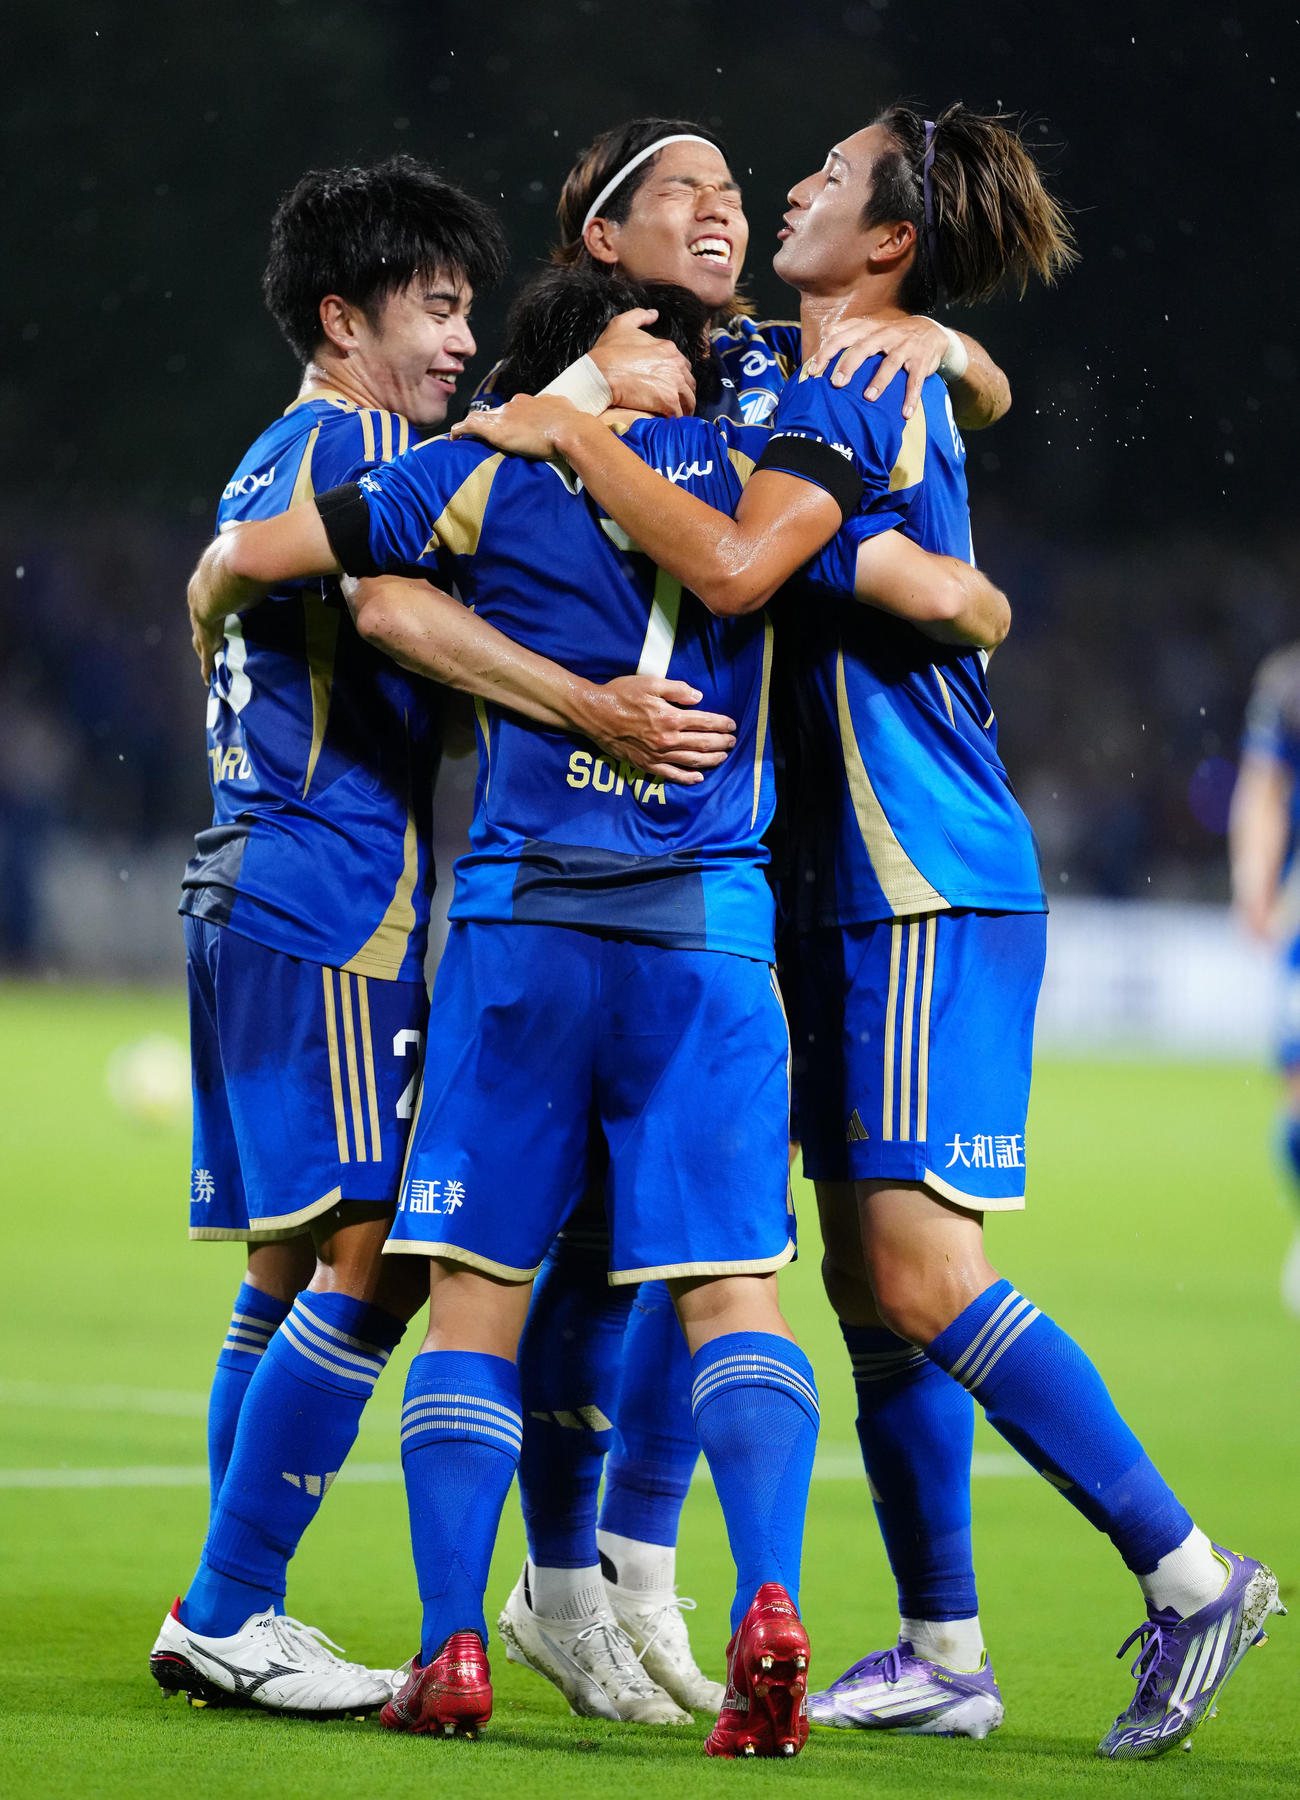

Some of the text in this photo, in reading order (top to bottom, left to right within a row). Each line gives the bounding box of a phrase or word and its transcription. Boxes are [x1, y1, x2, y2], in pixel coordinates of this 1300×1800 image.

[566, 751, 667, 805] SOMA
[944, 1133, 1026, 1168] 大和証
[190, 1168, 215, 1203] 券
[398, 1180, 466, 1215] 証券
